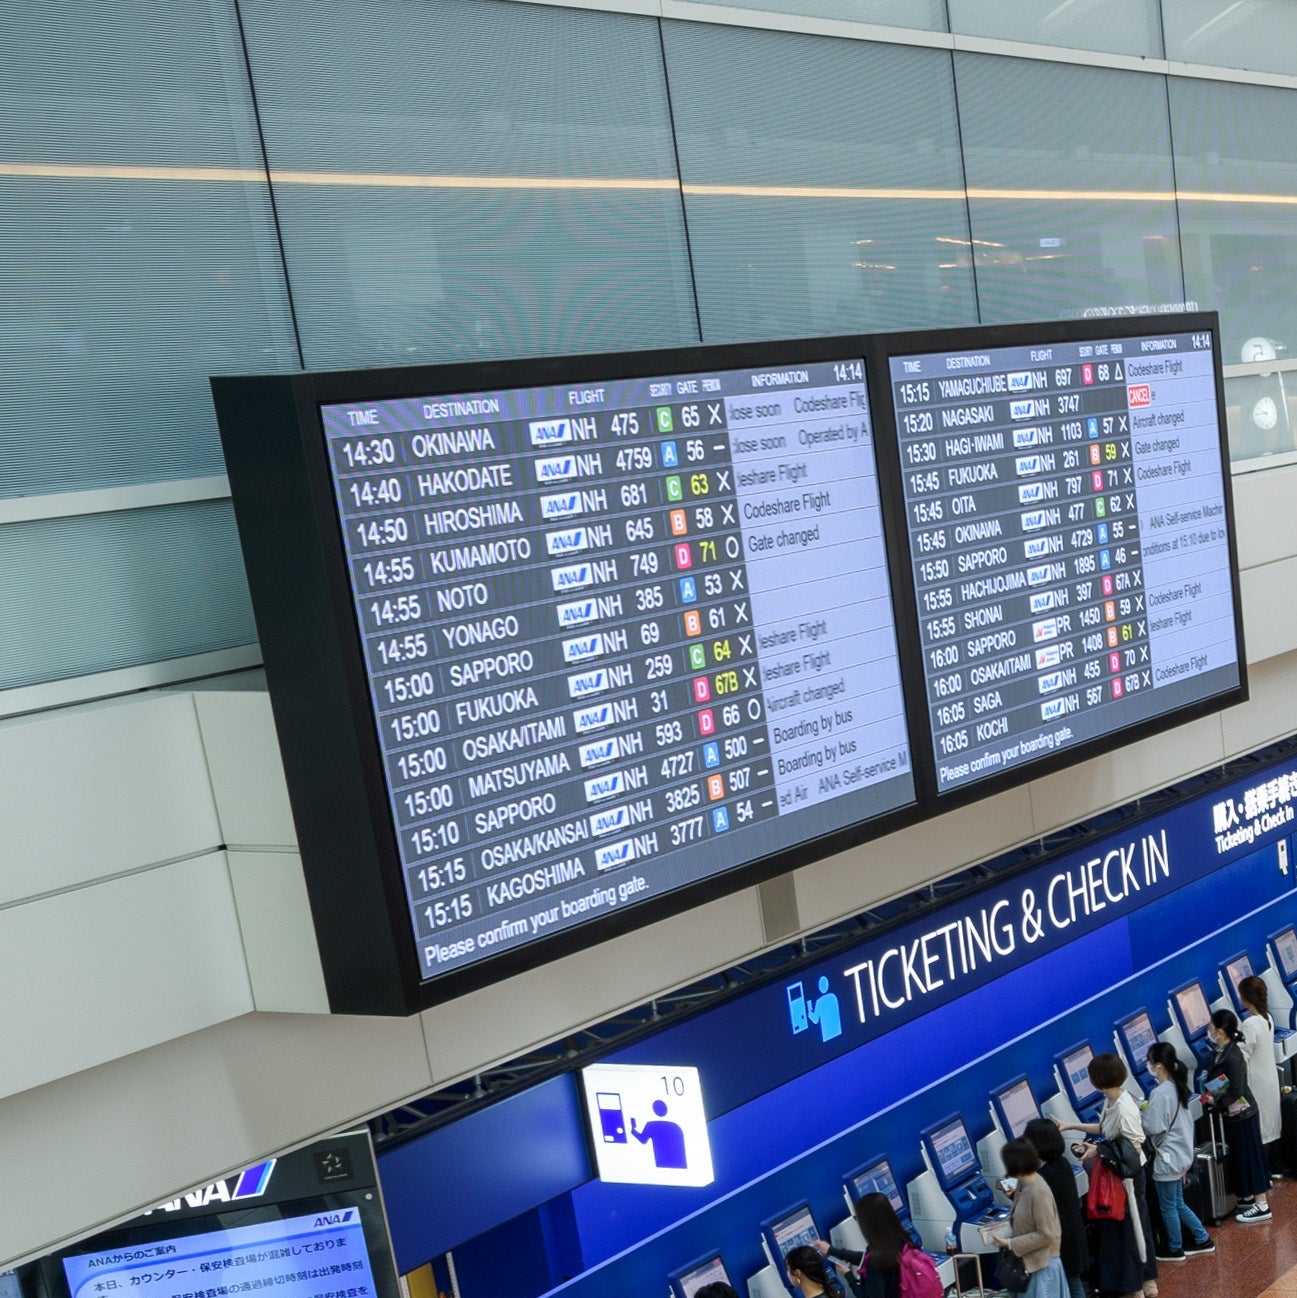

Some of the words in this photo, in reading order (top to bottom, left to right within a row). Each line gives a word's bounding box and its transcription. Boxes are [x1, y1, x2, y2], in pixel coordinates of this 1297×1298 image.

[946, 355, 990, 369] DESTINATION
[1192, 335, 1210, 349] 14:14
[347, 410, 378, 426] TIME
[424, 399, 499, 419] DESTINATION
[569, 389, 604, 404] FLIGHT
[677, 382, 698, 395] GATE
[751, 370, 809, 388] INFORMATION
[833, 363, 863, 382] 14:14
[900, 383, 930, 403] 15:15
[938, 374, 1007, 399] YAMAGUCHIUBE
[904, 412, 933, 434] 15:20
[942, 405, 994, 428] NAGASAKI
[907, 442, 936, 463] 15:30
[945, 432, 1004, 457] HAGI·IWAMI
[1159, 410, 1184, 426] changed
[343, 438, 395, 467] 14:30
[412, 428, 495, 457] OKINAWA
[350, 478, 401, 507] 14:40
[417, 464, 513, 496] HAKODATE
[910, 471, 940, 493] 15:45
[948, 463, 998, 487] FUKUOKA
[357, 517, 408, 547] 14:50
[424, 501, 523, 535] HIROSHIMA
[913, 500, 943, 523] 15:45
[952, 496, 976, 515] OITA
[364, 556, 414, 586] 14:55
[431, 537, 531, 574] KUMAMOTO
[744, 496, 800, 520] Codeshare
[803, 491, 831, 511] Flight
[917, 529, 946, 552] 15:45
[955, 519, 1002, 544] OKINAWA
[371, 595, 421, 625] 14:55
[436, 582, 488, 612] NOTO
[749, 533, 773, 553] Gate
[776, 525, 820, 548] changed
[920, 560, 949, 582] 15:50
[958, 548, 1007, 573] SAPPORO
[924, 588, 952, 611] 15:55
[961, 572, 1027, 600] HACHIJOJIMA
[377, 634, 428, 664] 14:55
[443, 615, 519, 649] YONAGO
[927, 616, 956, 640] 15:55
[964, 605, 1003, 630] SHONAI
[930, 645, 959, 669] 16:00
[967, 630, 1016, 658] SAPPORO
[384, 672, 434, 703] 15:00
[450, 650, 534, 687] SAPPORO
[933, 674, 962, 698] 16:00
[971, 654, 1031, 686] OSAKA/ITAMI
[391, 710, 441, 742] 15:00
[456, 687, 538, 725] FUKUOKA
[937, 702, 965, 727] 16:05
[974, 692, 1003, 715] SAGA
[398, 747, 447, 780] 15:00
[463, 716, 566, 761] OSAKA/ITAMI
[940, 730, 968, 755] 16:05
[977, 717, 1008, 742] KOCHI
[405, 785, 453, 817] 15:00
[468, 752, 571, 799] MATSUYAMA
[412, 821, 460, 855] 15:10
[475, 793, 556, 834] SAPPORO
[774, 719, 818, 744] Boarding
[821, 716, 833, 733] by
[836, 709, 853, 728] bus
[1214, 825, 1254, 854] Ticketing
[1254, 819, 1262, 836] &
[1261, 810, 1286, 833] Check
[1286, 806, 1295, 821] In
[418, 857, 466, 891] 15:15
[481, 819, 588, 869] OSAKA/KANSAI
[425, 894, 473, 928] 15:15
[487, 857, 585, 907] KAGOSHIMA
[425, 937, 475, 966] Please
[478, 912, 528, 948] confirm
[531, 906, 559, 931] your
[562, 886, 616, 917] boarding
[619, 875, 650, 902] gate.
[844, 896, 1016, 1025] TICKETING
[1020, 892, 1045, 940] &
[1046, 846, 1139, 931] CHECK
[1140, 829, 1171, 885] IN
[661, 1076, 684, 1096] 10
[314, 1216, 341, 1229] ANA
[87, 1244, 177, 1268] ANAからのご案内
